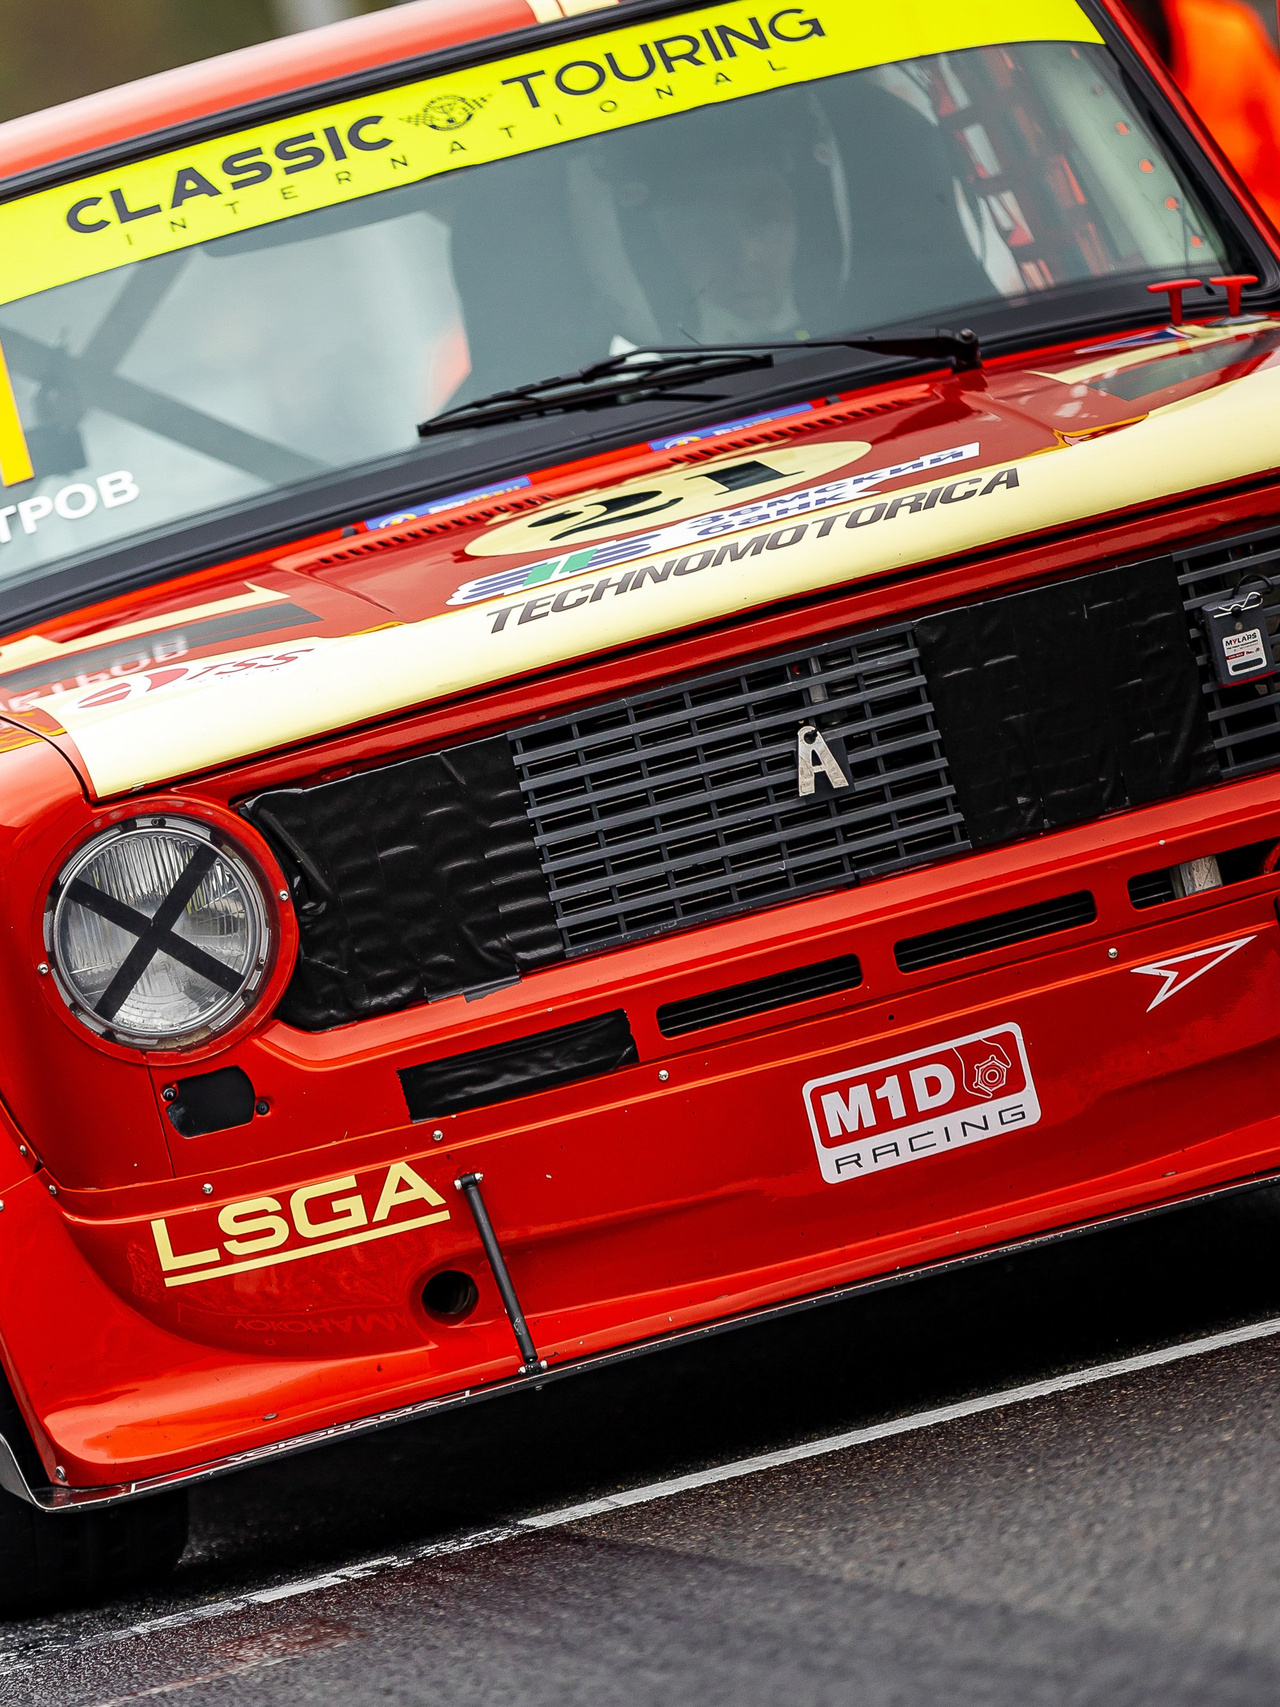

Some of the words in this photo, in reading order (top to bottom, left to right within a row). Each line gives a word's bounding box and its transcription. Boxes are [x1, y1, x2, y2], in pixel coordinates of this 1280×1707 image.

[66, 115, 394, 234] CLASSIC
[501, 8, 826, 109] TOURING
[126, 59, 787, 246] INTERNATIONAL
[527, 460, 806, 541] 21
[696, 489, 855, 537] банк
[487, 468, 1020, 634] TECHNOMOTORICA
[186, 648, 315, 681] TSS
[798, 726, 849, 796] A
[820, 1063, 956, 1139] M1D
[834, 1103, 1027, 1175] RACING
[150, 1161, 447, 1272] LSGA
